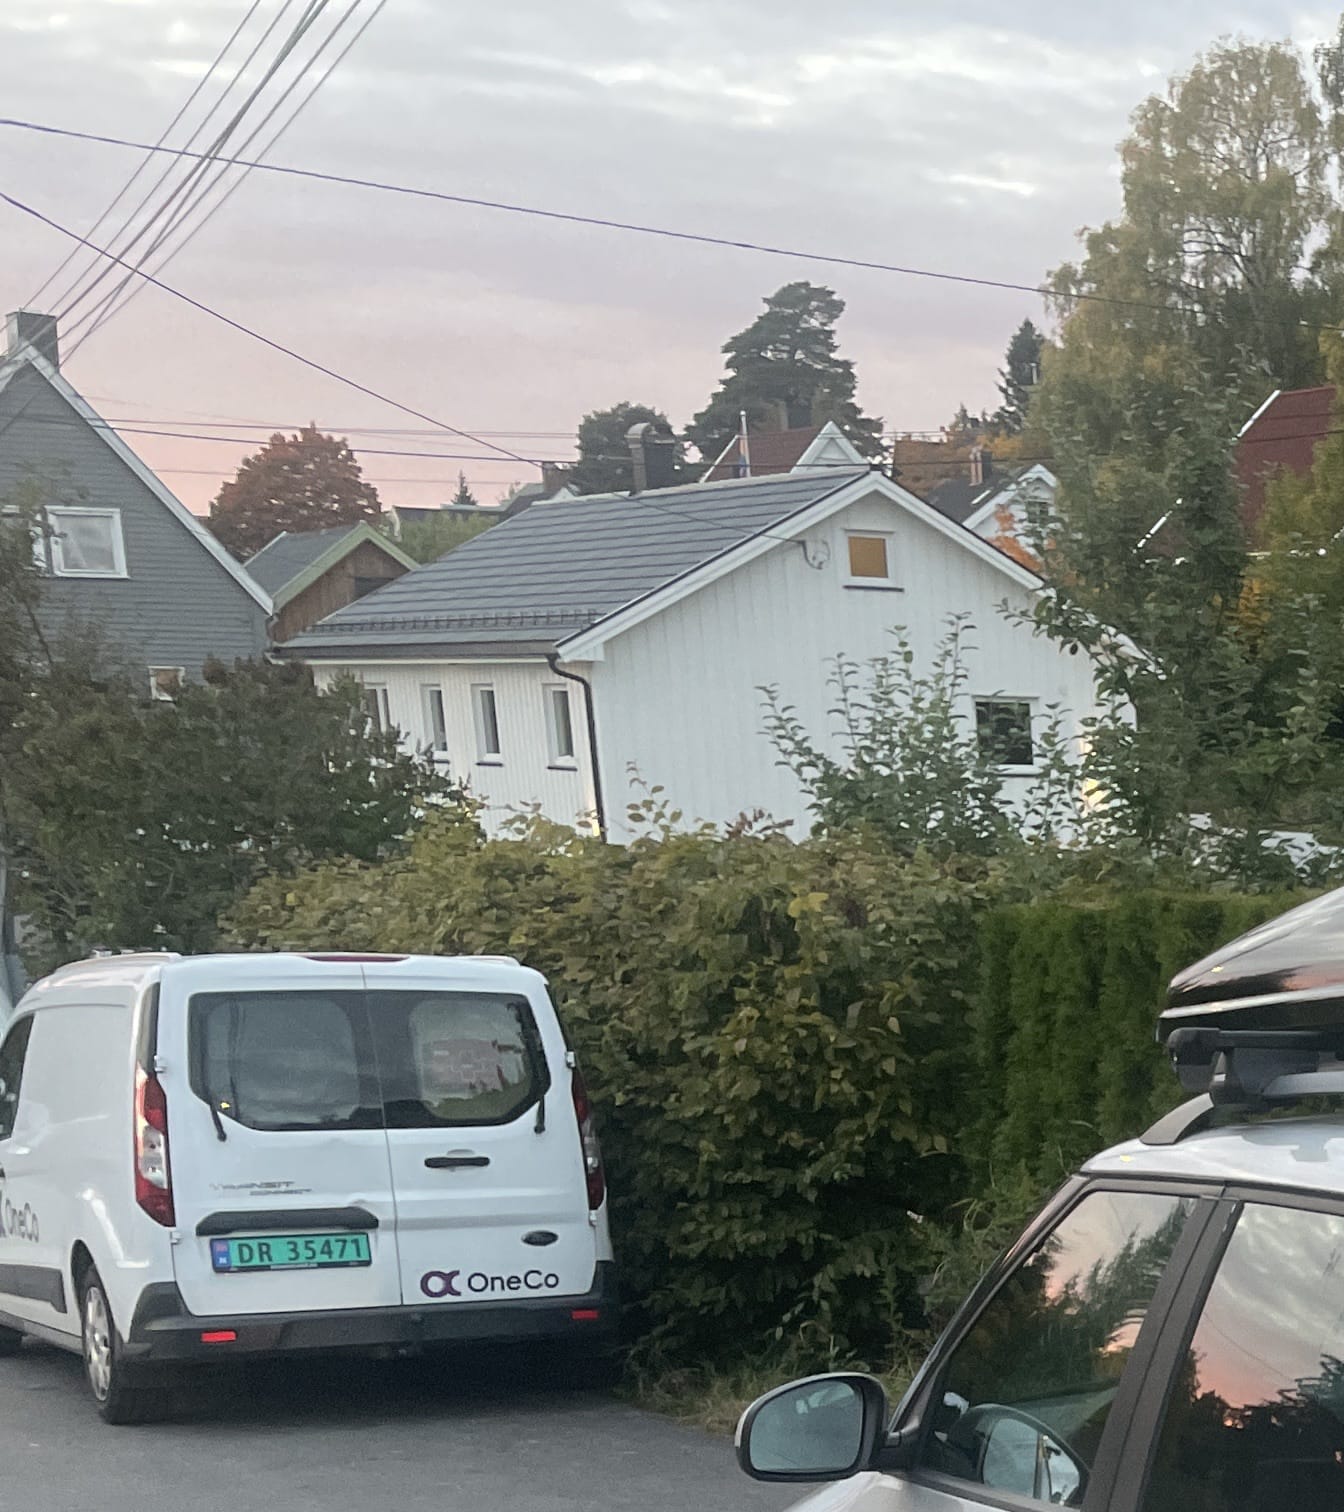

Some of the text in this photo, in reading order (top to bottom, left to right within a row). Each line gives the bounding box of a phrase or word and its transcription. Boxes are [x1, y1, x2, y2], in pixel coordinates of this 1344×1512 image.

[237, 1239, 362, 1264] DR 35471
[467, 1270, 560, 1293] OneCo
